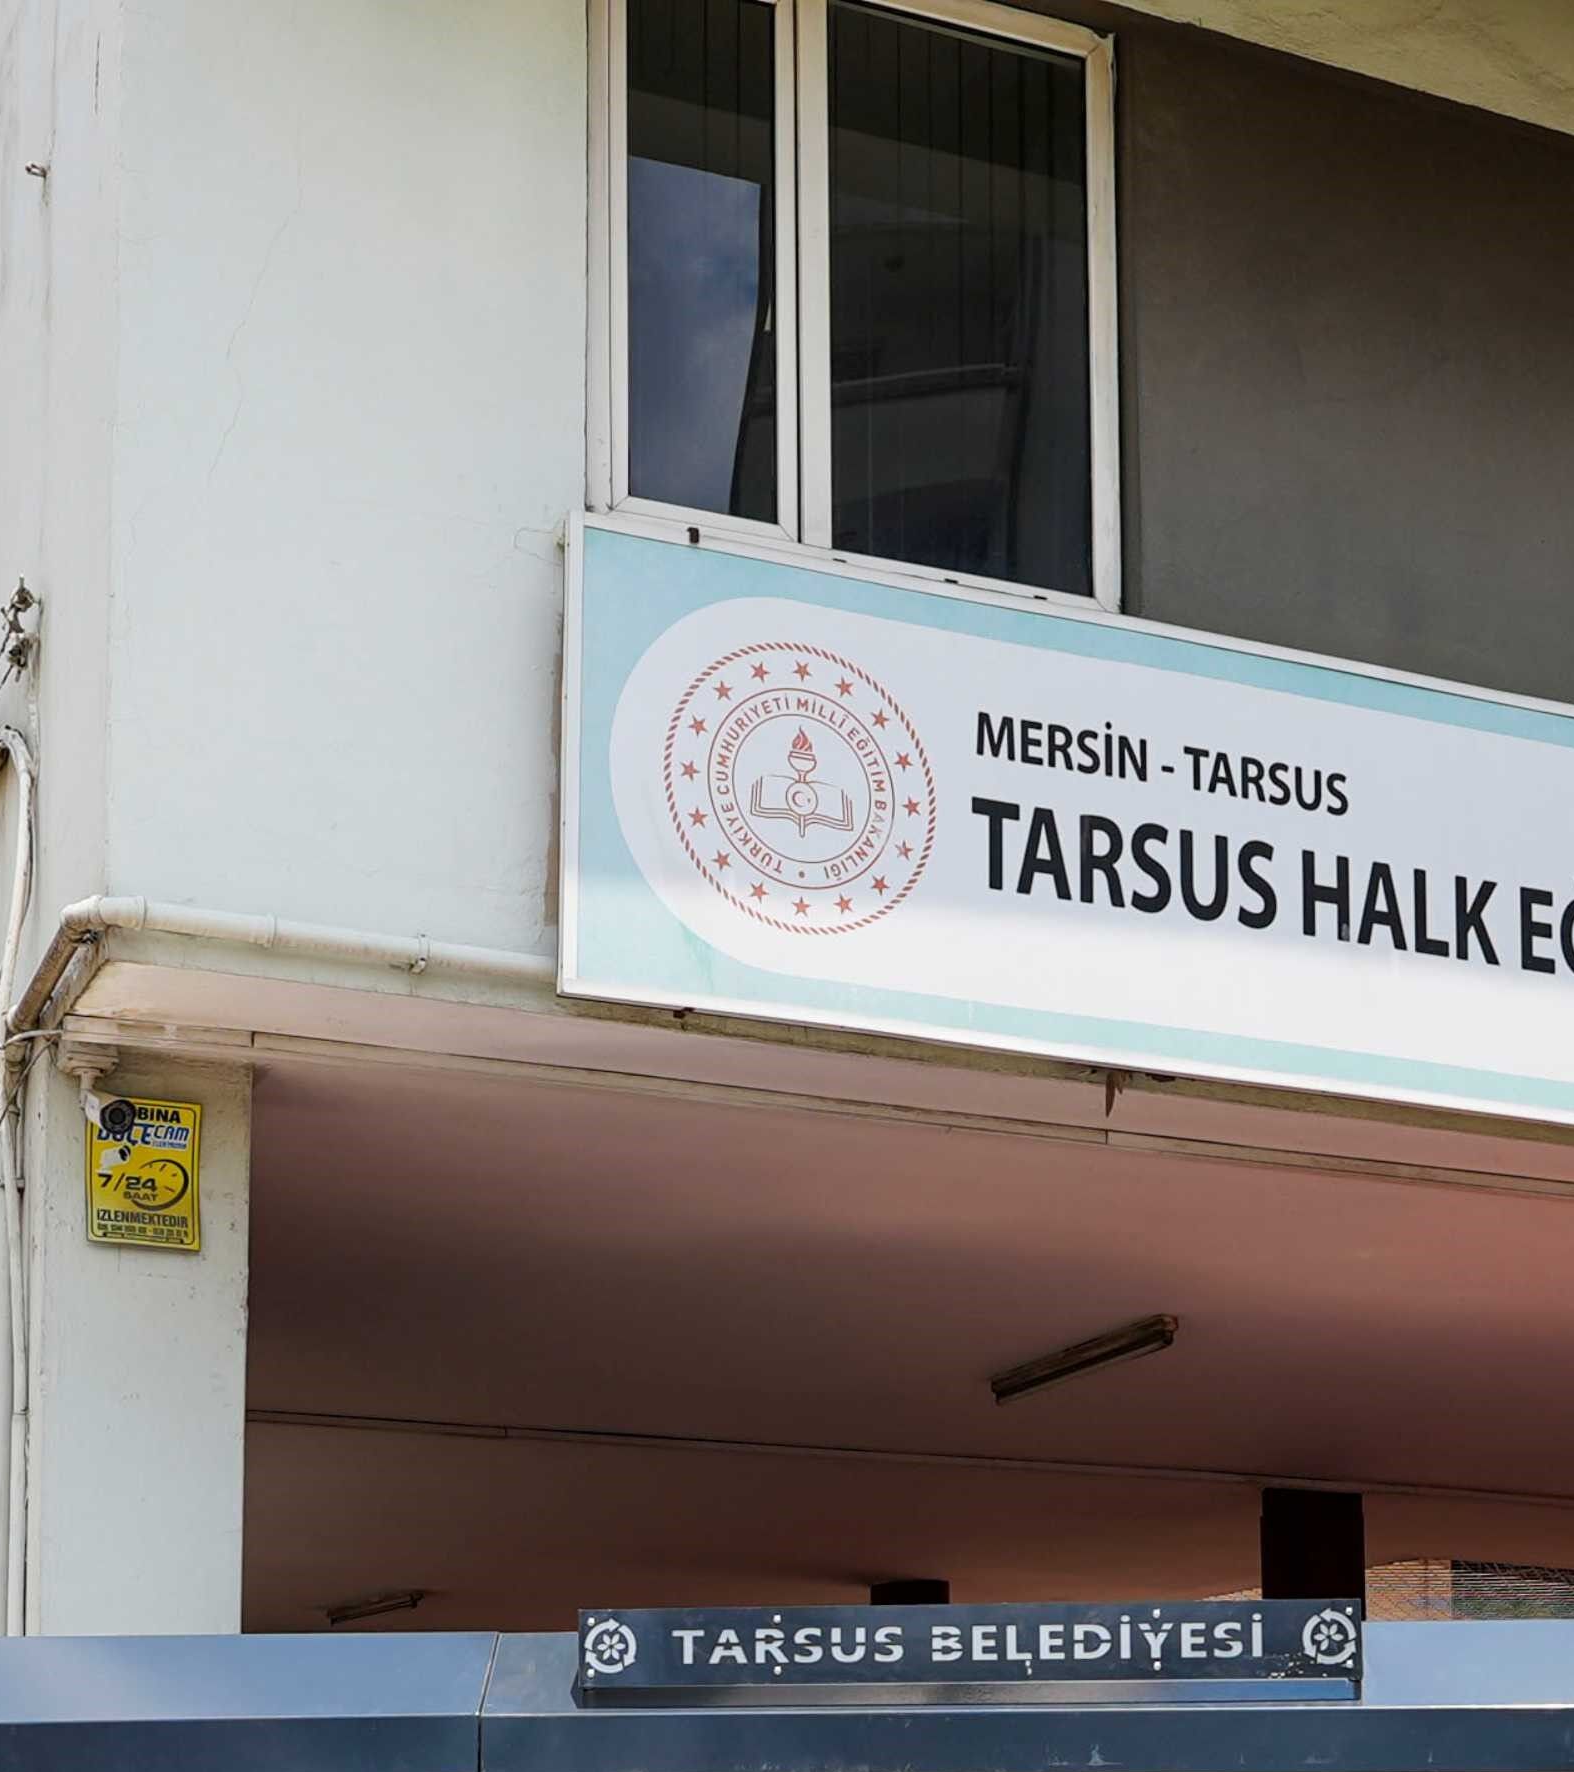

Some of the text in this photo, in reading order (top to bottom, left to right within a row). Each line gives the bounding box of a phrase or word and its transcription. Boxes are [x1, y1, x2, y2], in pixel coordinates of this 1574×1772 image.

[976, 711, 1148, 783] MERSİN
[1183, 745, 1349, 817] TARSUS
[972, 796, 1278, 930] TARSUS
[1301, 849, 1500, 966] HALK
[97, 1173, 158, 1192] 7/24
[671, 1613, 1264, 1664] TARSUS BELEDİYESİ
